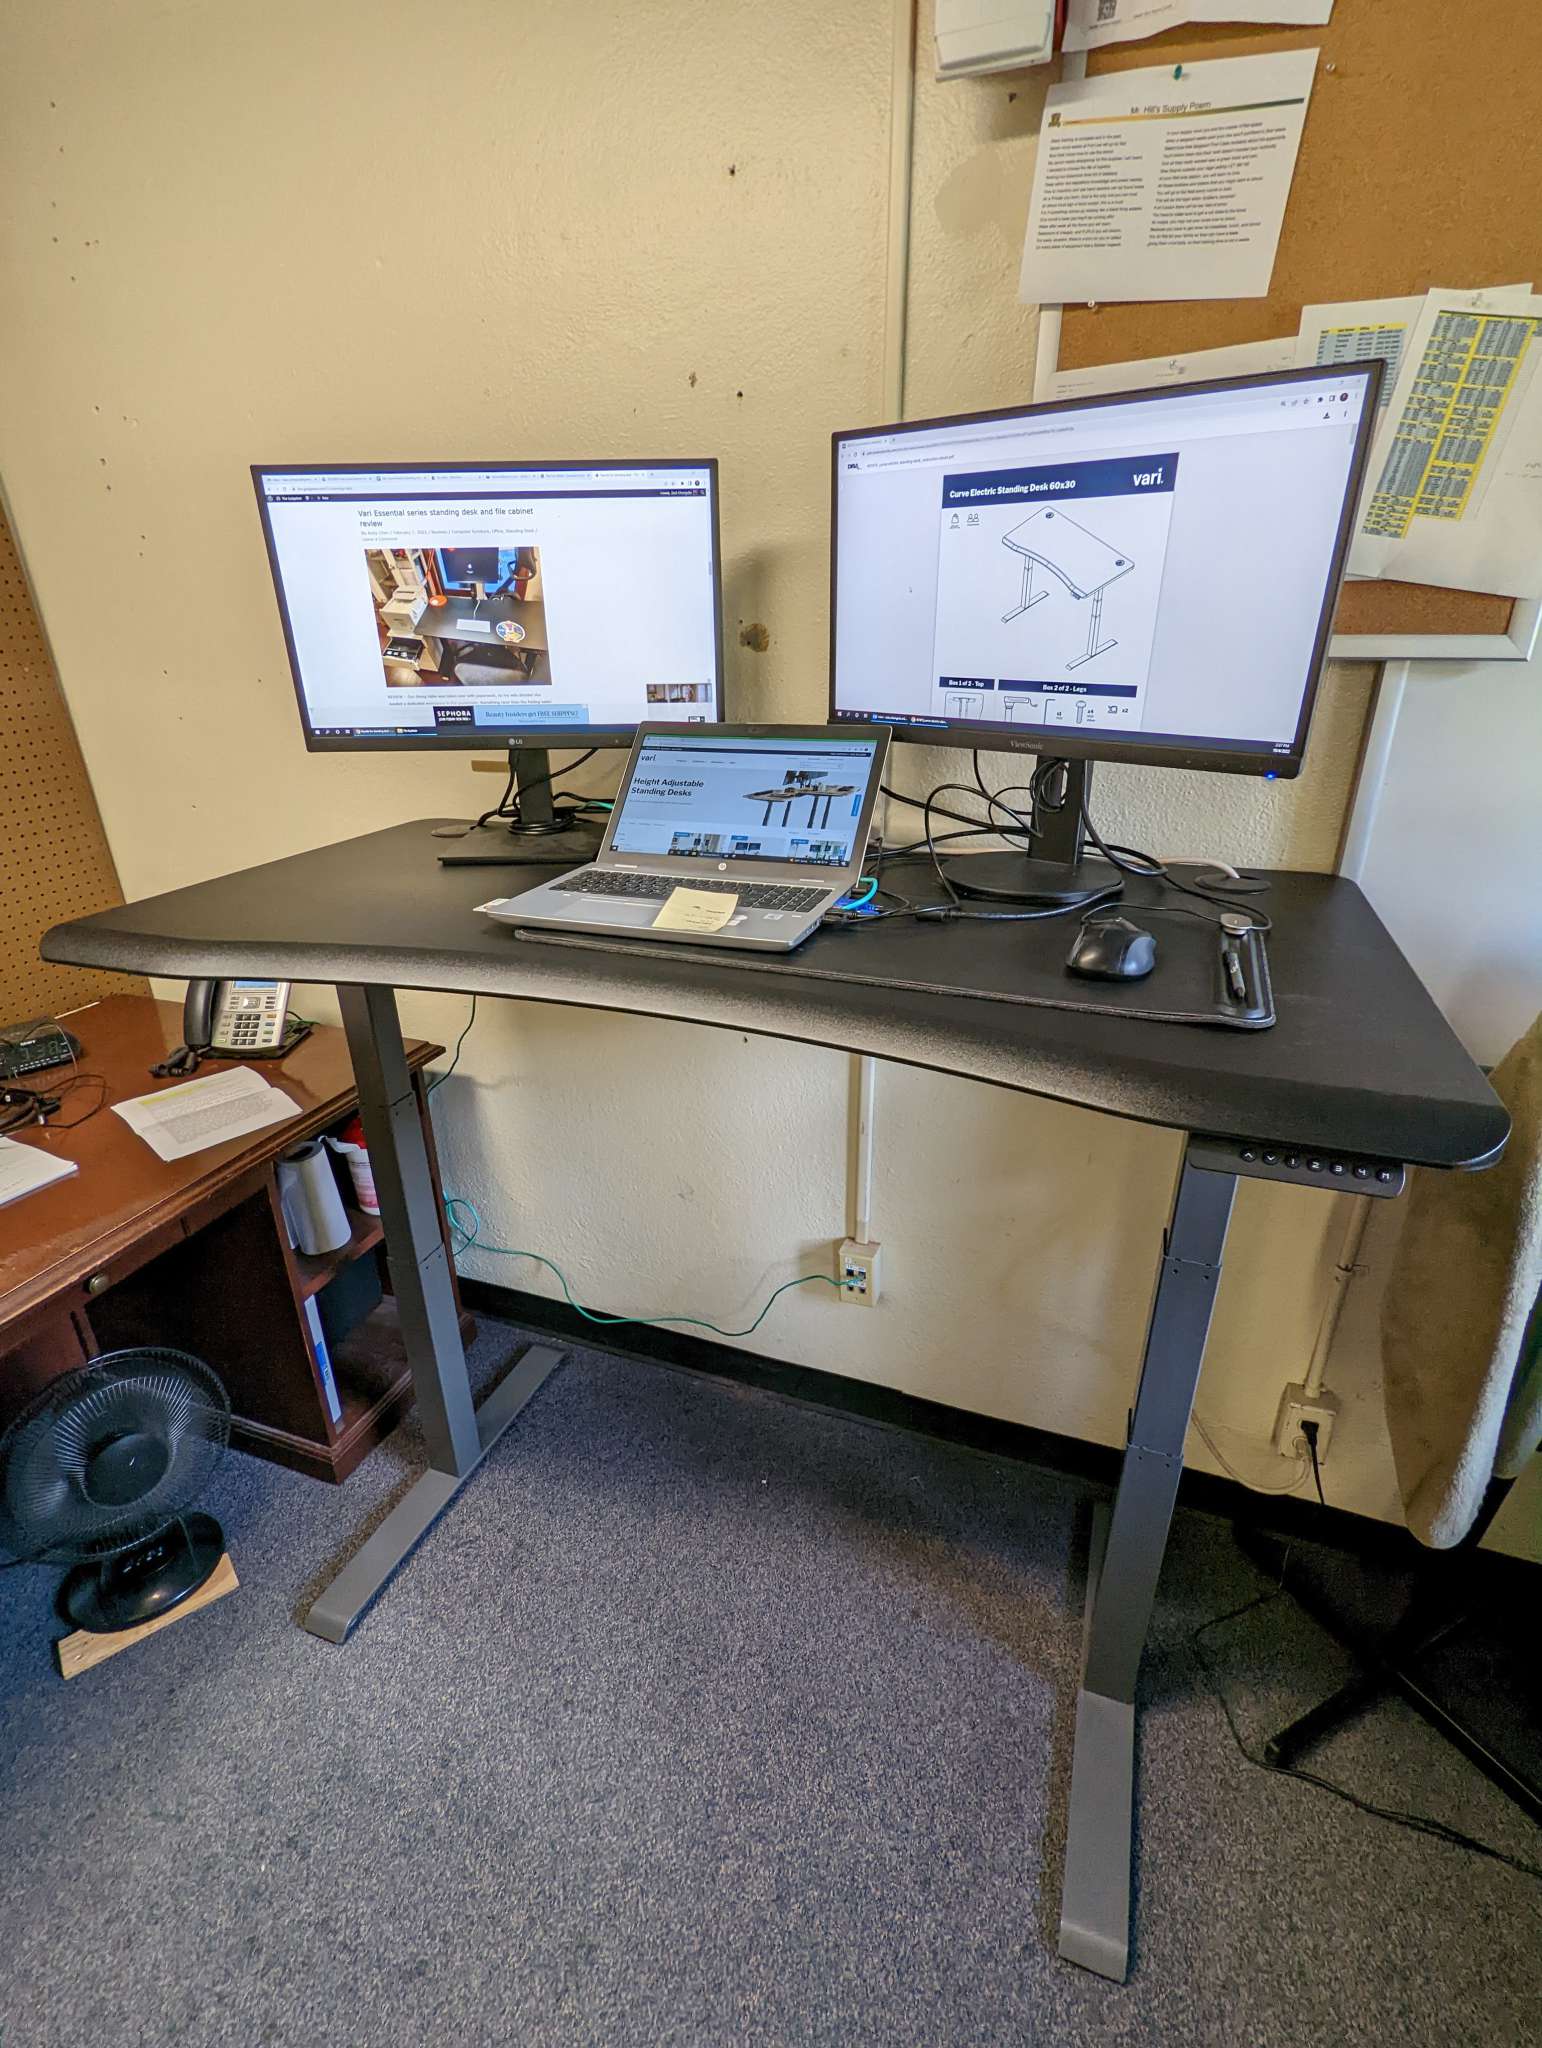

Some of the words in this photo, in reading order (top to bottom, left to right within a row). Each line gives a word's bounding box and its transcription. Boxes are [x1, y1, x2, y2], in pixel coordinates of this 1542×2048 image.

[949, 489, 969, 499] Curve
[970, 487, 996, 497] Electric
[997, 485, 1029, 496] Standing
[1029, 482, 1049, 492] Desk
[1049, 480, 1076, 490] 60x30
[358, 509, 372, 517] Vari
[374, 509, 405, 517] Essential
[429, 508, 460, 518] standing
[461, 508, 478, 516] desk
[507, 507, 534, 515] cabinet
[633, 777, 660, 787] Height
[661, 779, 704, 789] Adjustable
[631, 786, 666, 797] Standing
[667, 788, 692, 797] Desks
[1335, 1165, 1343, 1173] 3
[1358, 1168, 1366, 1177] 4
[1382, 1172, 1390, 1180] M
